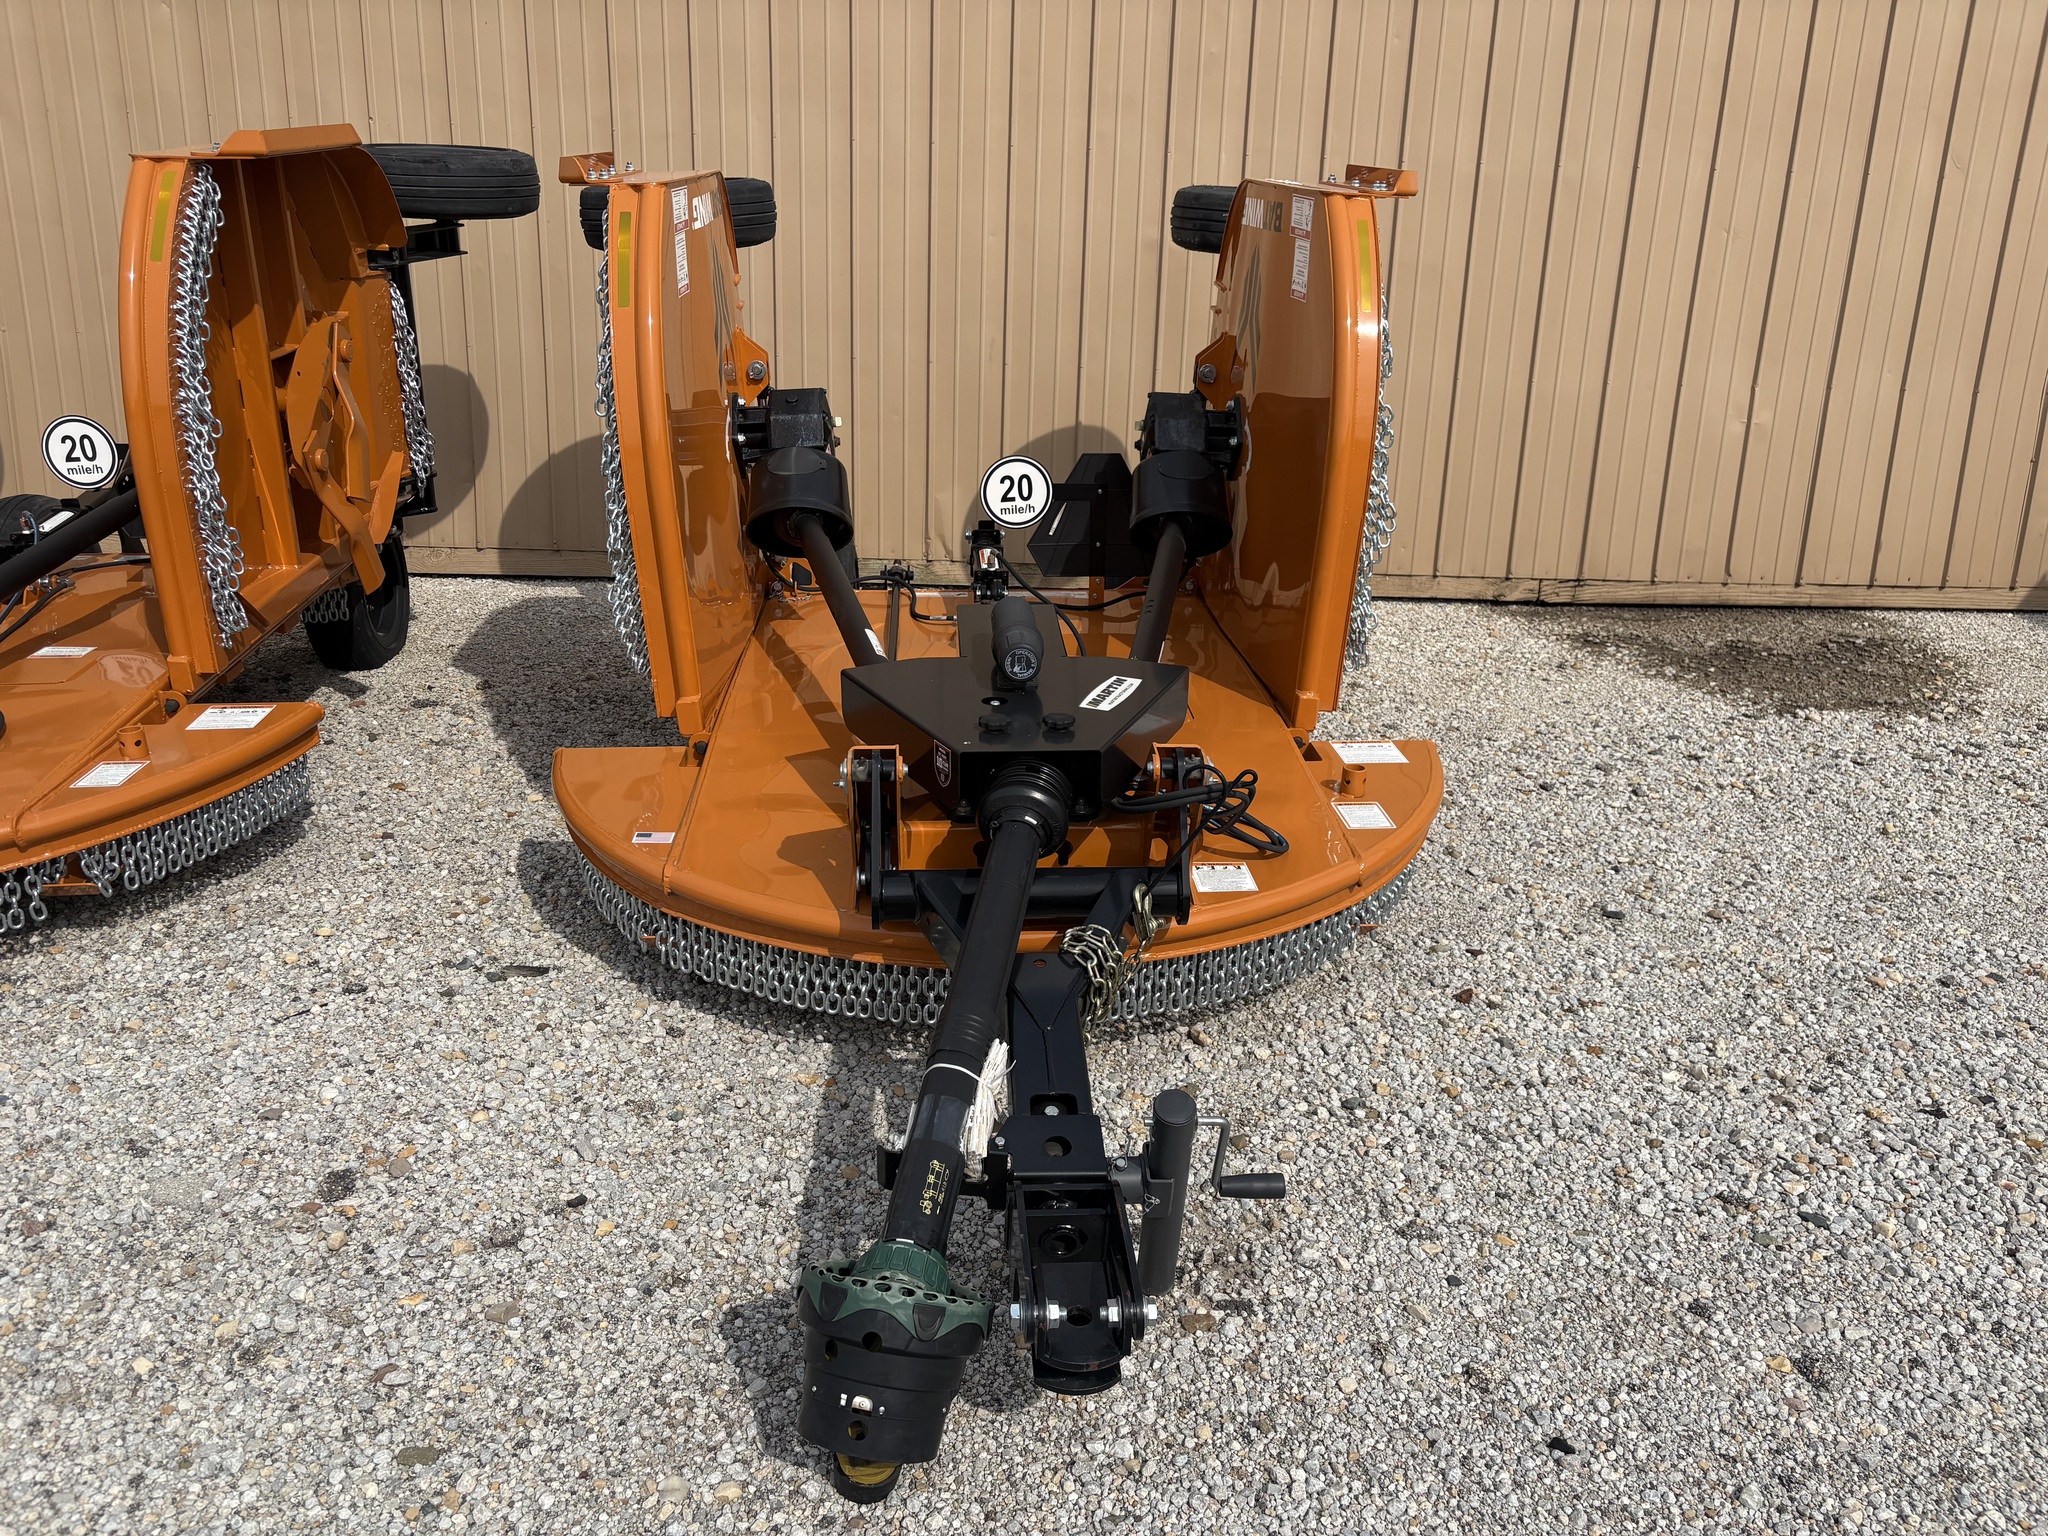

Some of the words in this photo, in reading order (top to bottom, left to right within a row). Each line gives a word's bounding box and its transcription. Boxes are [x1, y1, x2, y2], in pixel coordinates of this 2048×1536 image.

[61, 434, 97, 462] 20
[67, 464, 104, 475] mile/h
[999, 474, 1033, 502] 20
[1000, 504, 1035, 515] mile/h
[1085, 677, 1127, 708] MARTIN
